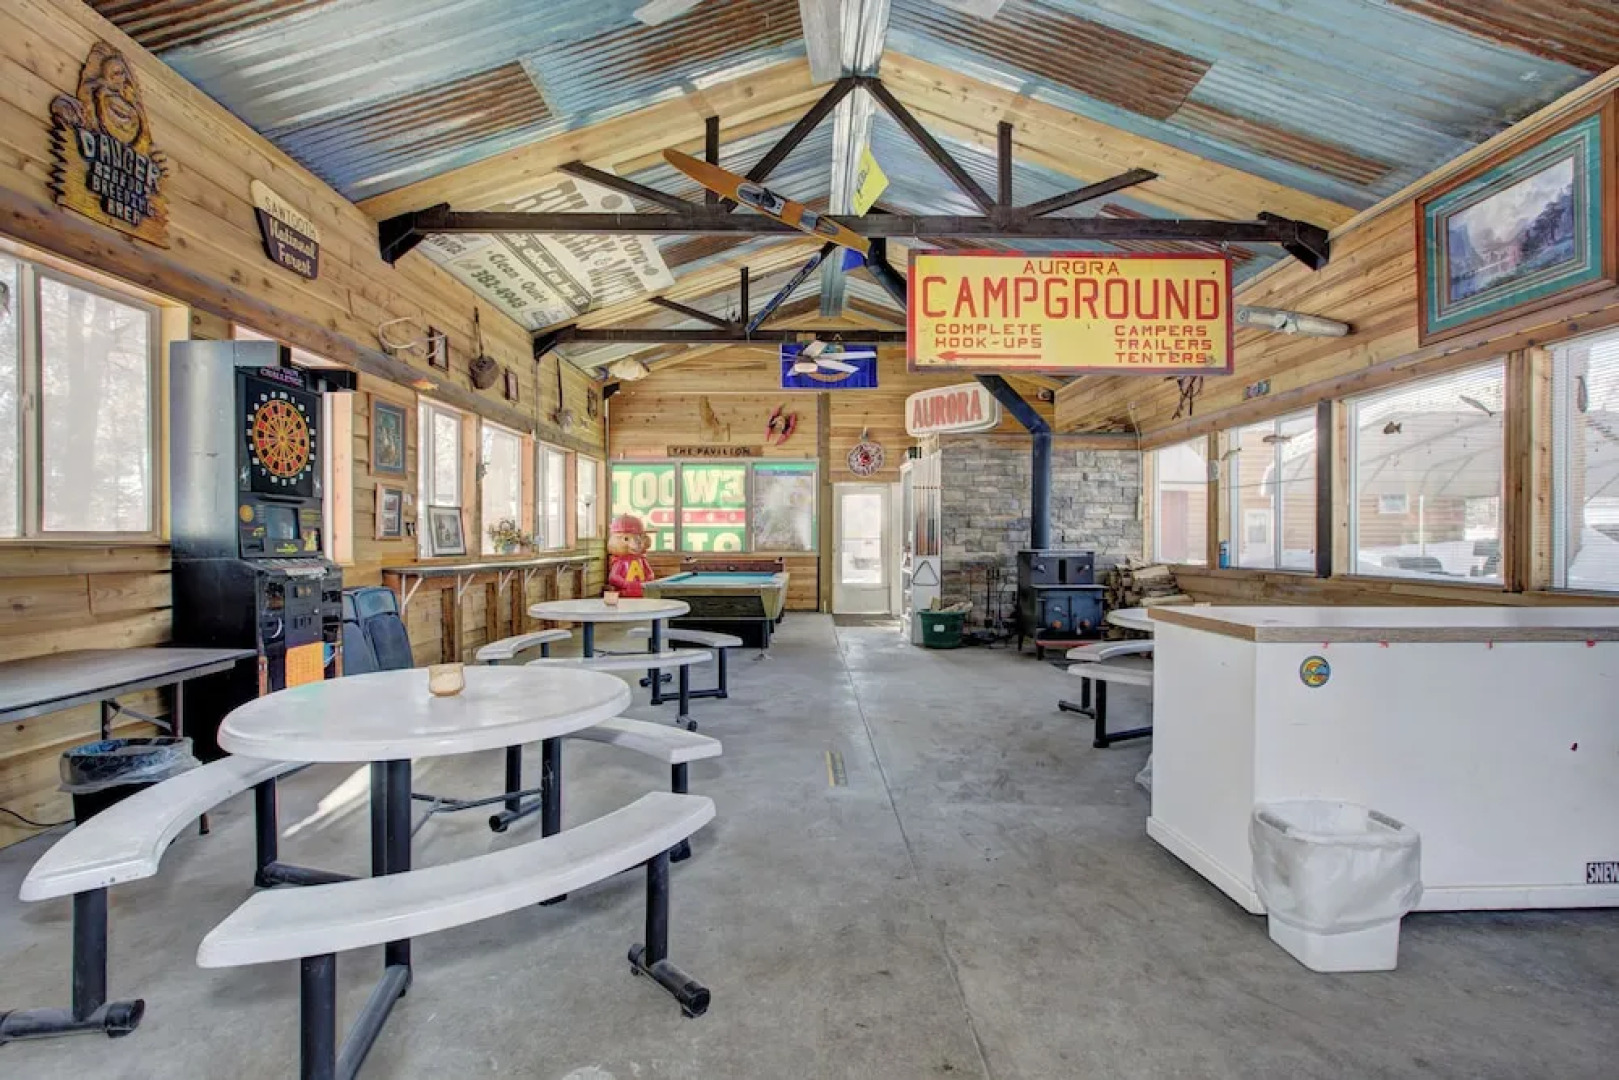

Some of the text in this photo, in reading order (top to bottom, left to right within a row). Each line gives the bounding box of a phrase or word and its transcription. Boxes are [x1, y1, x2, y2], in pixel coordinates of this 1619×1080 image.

[80, 129, 161, 194] DANGER
[92, 174, 155, 217] BREEDING
[108, 199, 141, 225] AREA
[270, 216, 316, 259] National
[278, 242, 312, 275] Forest
[1023, 260, 1120, 275] AURORA
[922, 276, 1220, 320] CAMPGROUND
[935, 323, 1042, 335] COMPLETE
[1114, 325, 1208, 337] CAMPERS
[935, 337, 1042, 349] HOOK-UPS
[1115, 339, 1212, 351] TRAILERS
[1115, 352, 1208, 364] TENTERS
[912, 389, 983, 429] AURORA
[673, 447, 751, 457] THE PAVILION
[625, 559, 645, 583] A
